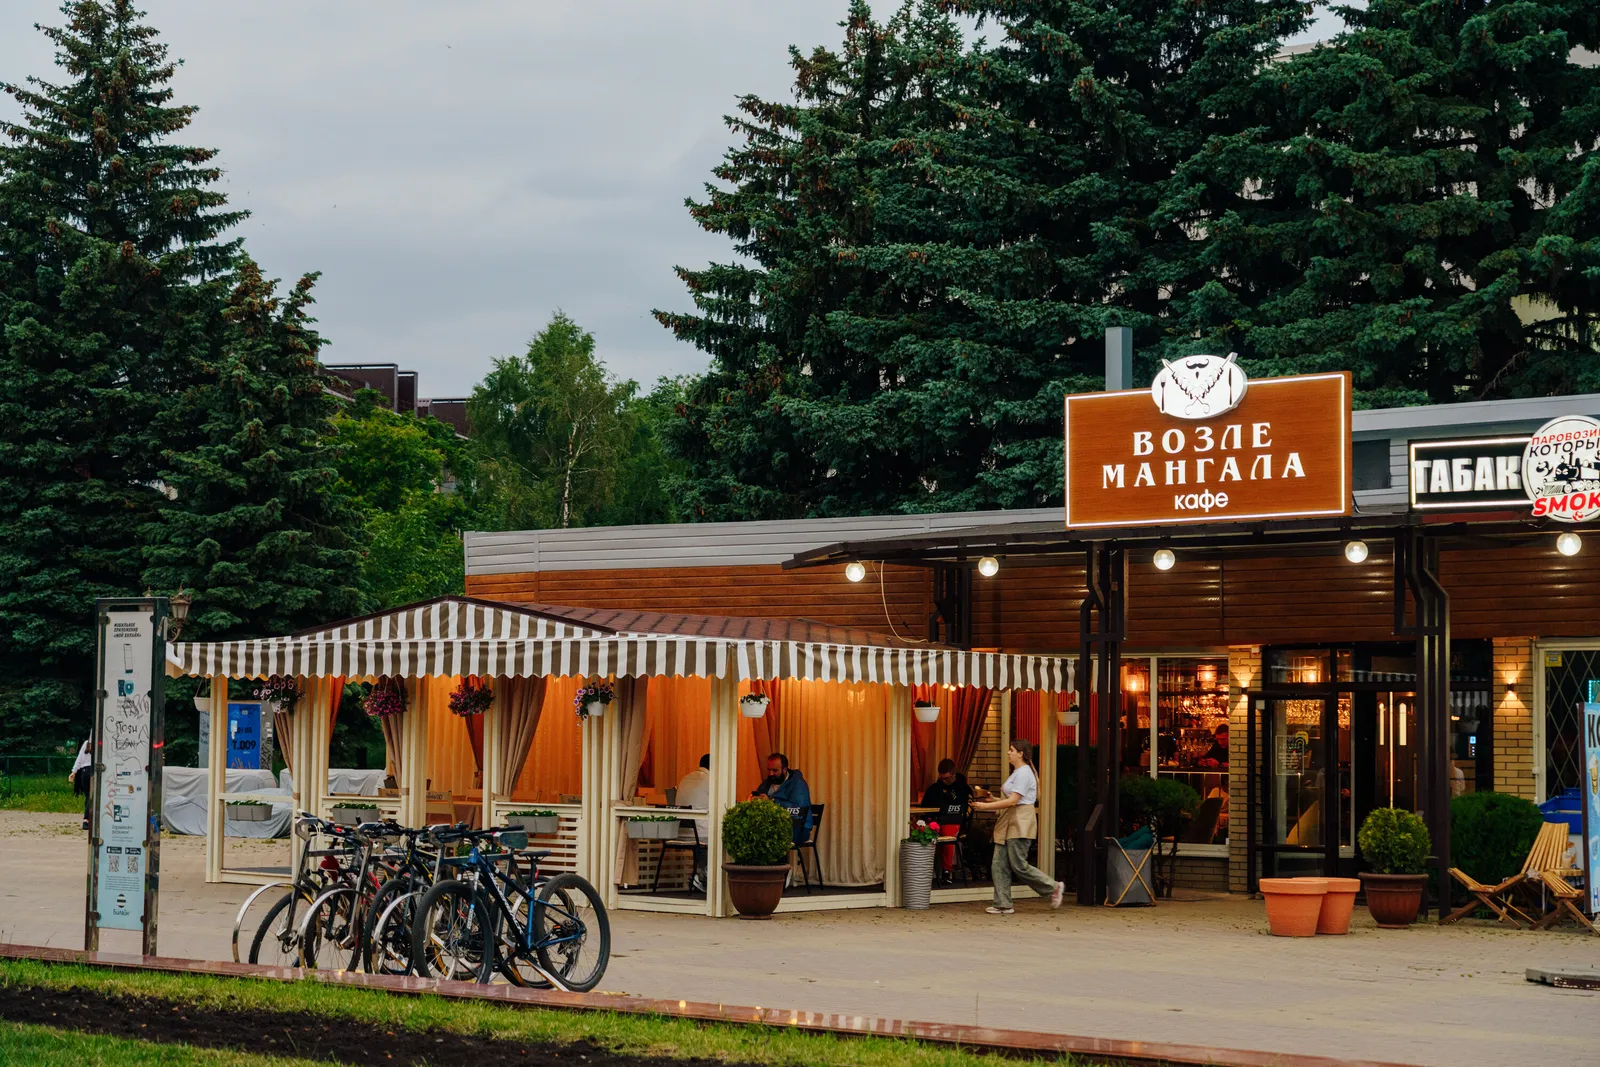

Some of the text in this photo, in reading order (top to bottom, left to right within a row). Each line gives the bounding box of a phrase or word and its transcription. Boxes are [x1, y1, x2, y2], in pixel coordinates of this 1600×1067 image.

[1133, 422, 1273, 457] ВОЗЛЕ
[1102, 452, 1306, 489] МАНГАЛА
[1413, 456, 1522, 494] ТАБАК
[1174, 488, 1229, 513] кафе
